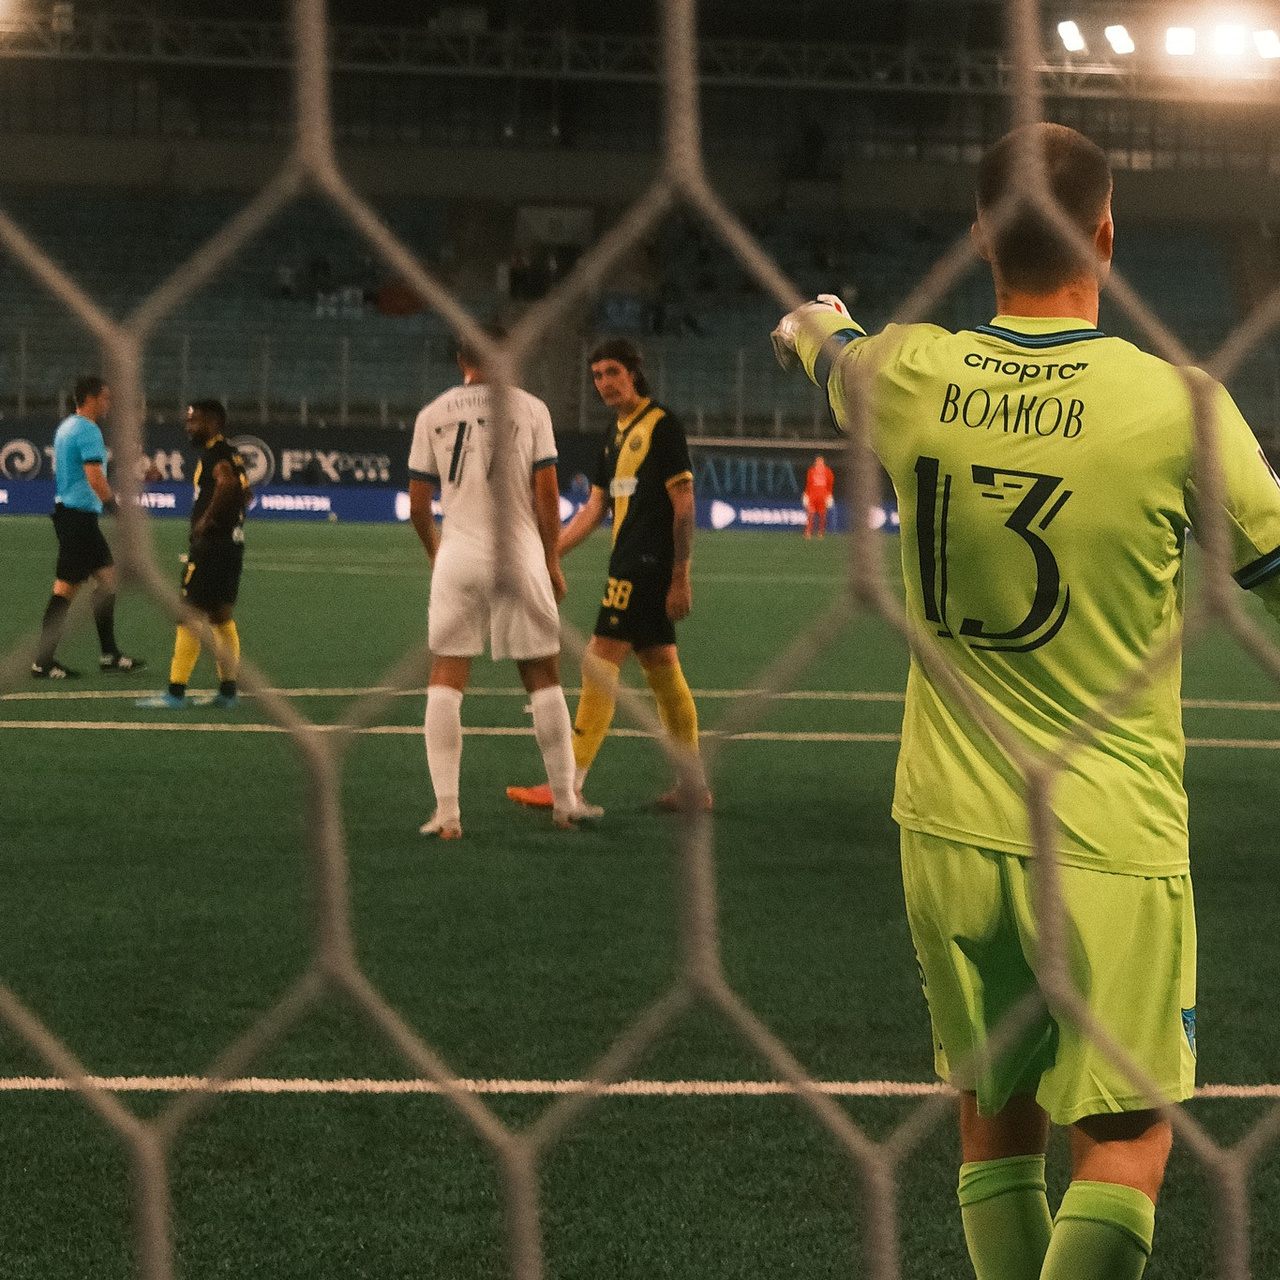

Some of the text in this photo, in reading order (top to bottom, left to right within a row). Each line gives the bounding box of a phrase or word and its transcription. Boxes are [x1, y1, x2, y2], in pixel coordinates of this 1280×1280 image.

[939, 383, 1085, 439] ВОЛКОВ
[914, 455, 1074, 653] 13
[602, 577, 633, 610] 38
